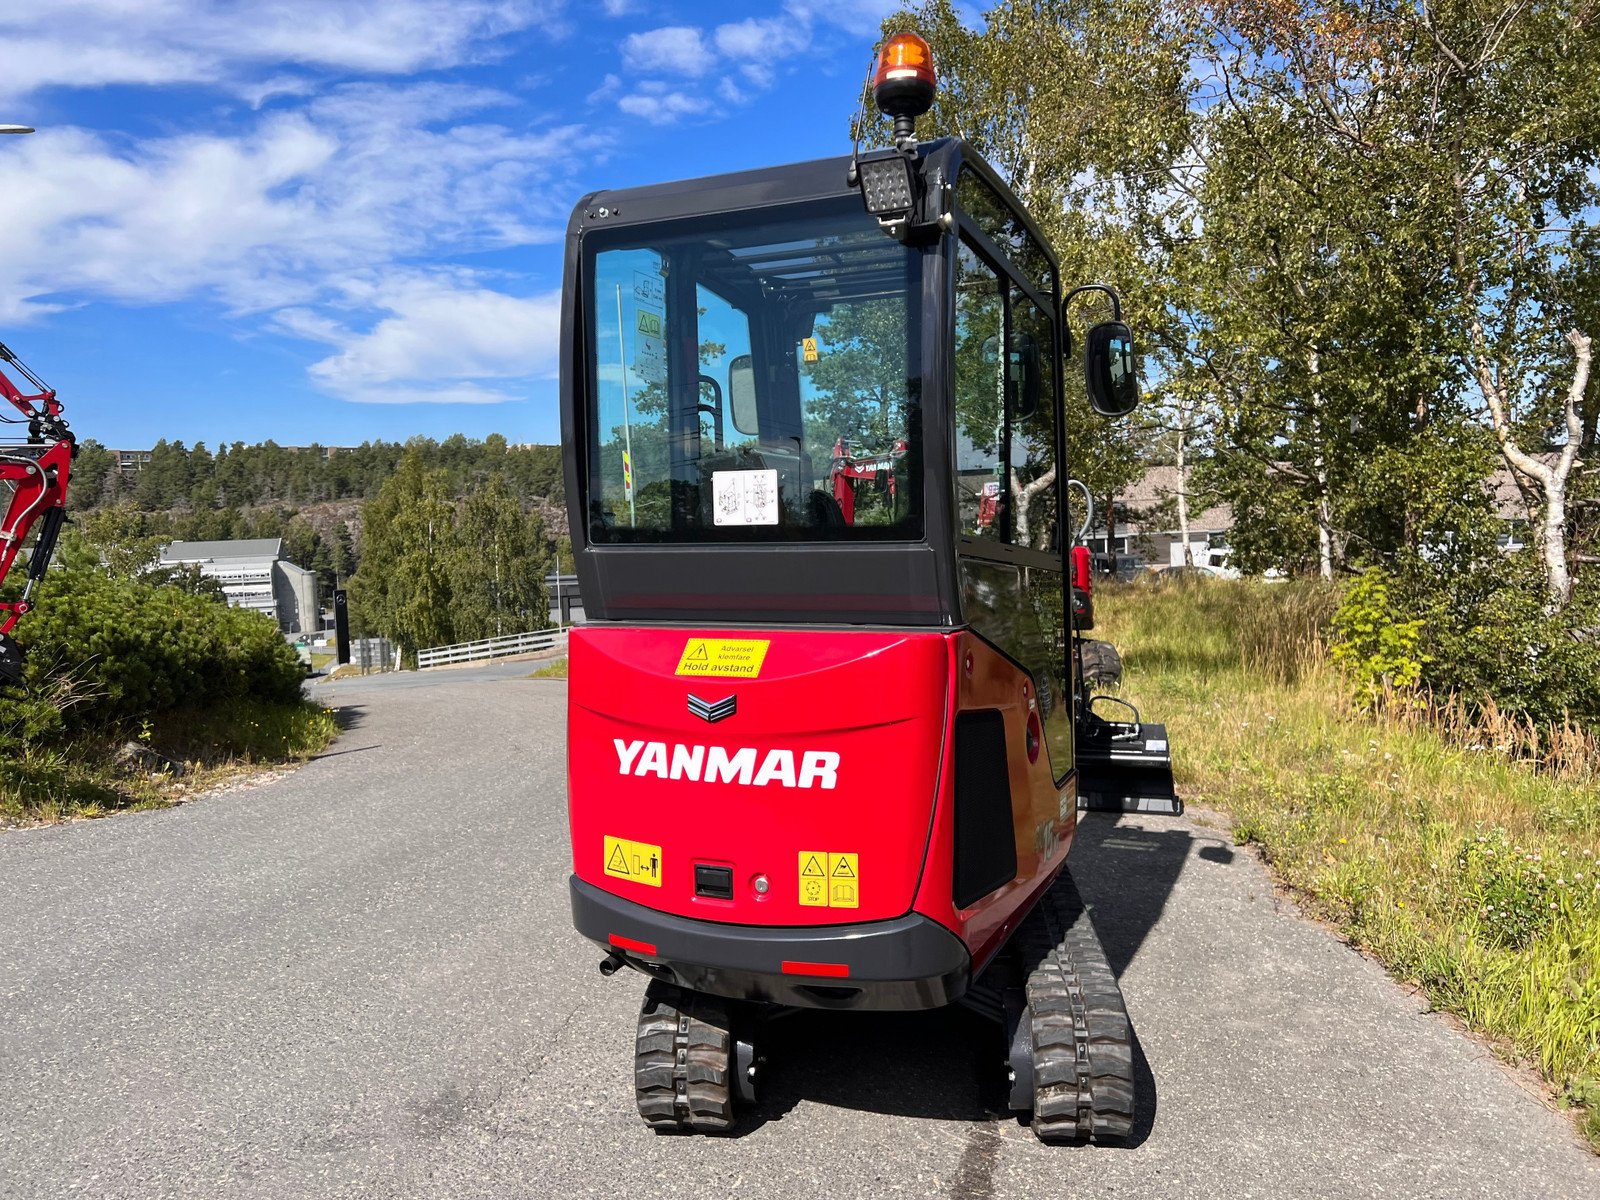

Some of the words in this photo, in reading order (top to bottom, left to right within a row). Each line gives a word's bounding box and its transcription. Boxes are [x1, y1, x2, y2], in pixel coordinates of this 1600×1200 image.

[683, 662, 709, 671] Hold
[711, 664, 754, 673] avstand
[613, 738, 840, 790] YANMAR
